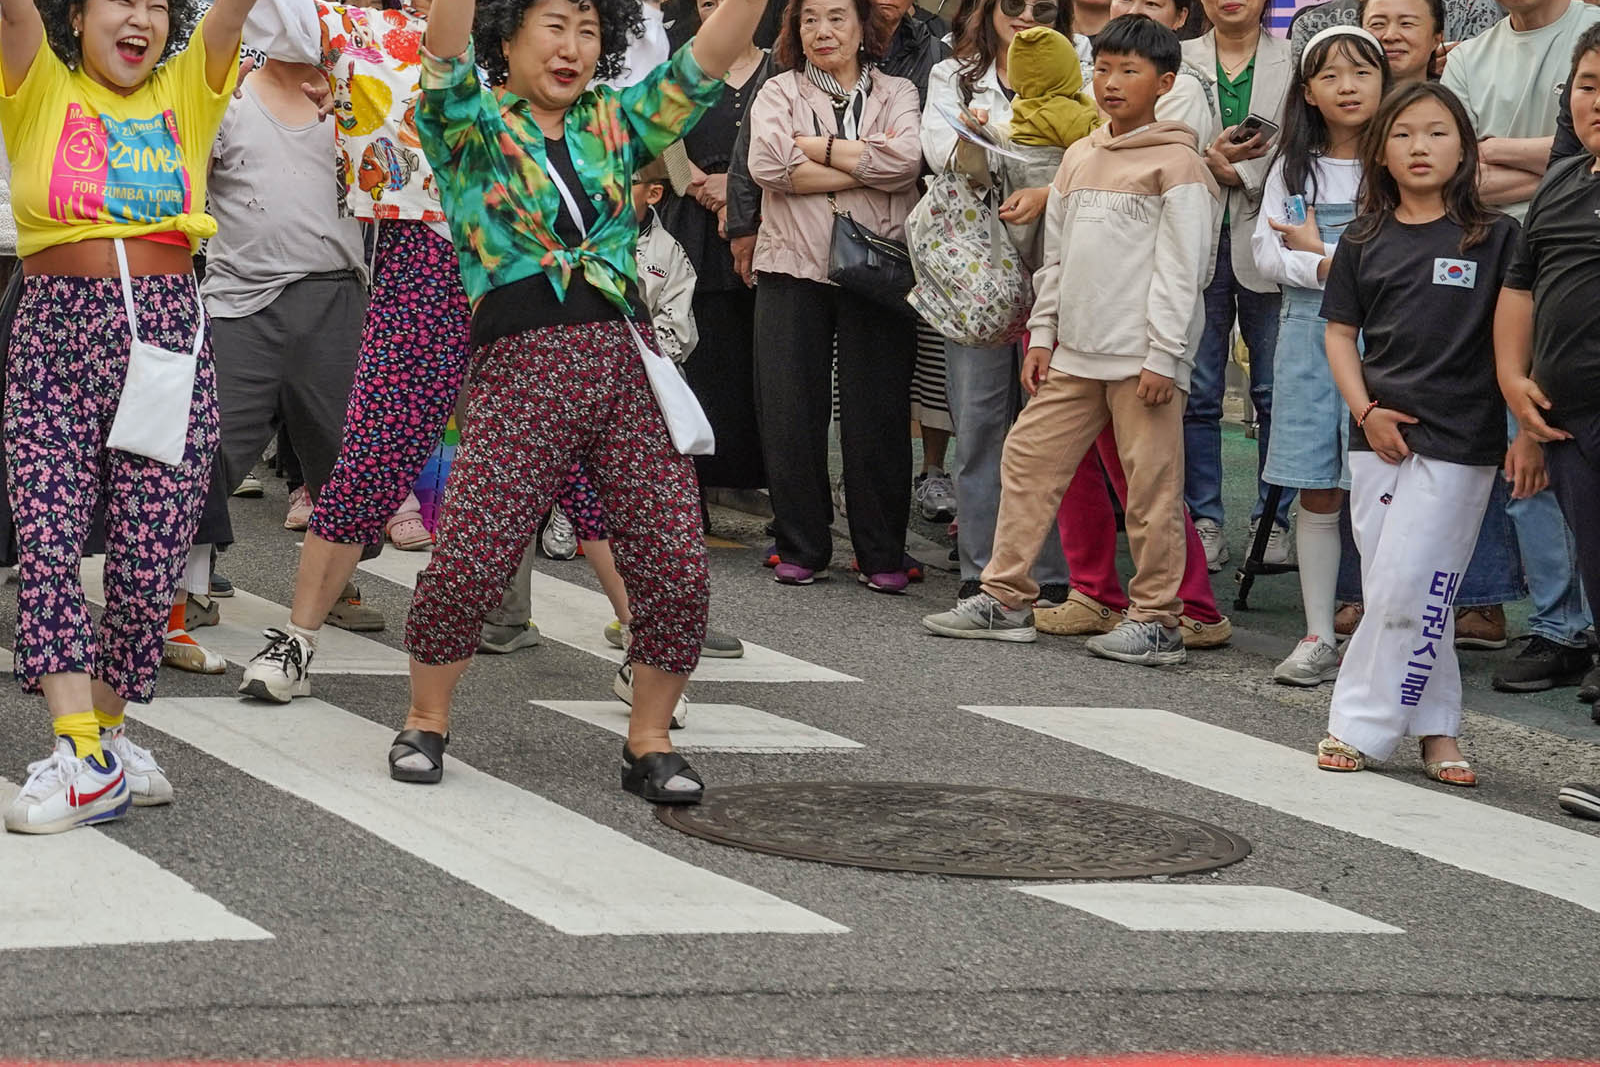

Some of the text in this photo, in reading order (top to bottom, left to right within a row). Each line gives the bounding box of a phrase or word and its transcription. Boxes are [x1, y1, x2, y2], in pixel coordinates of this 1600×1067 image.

[72, 181, 97, 195] FOR
[101, 185, 144, 201] ZUMBA
[1401, 571, 1460, 706] 태권스쿨
